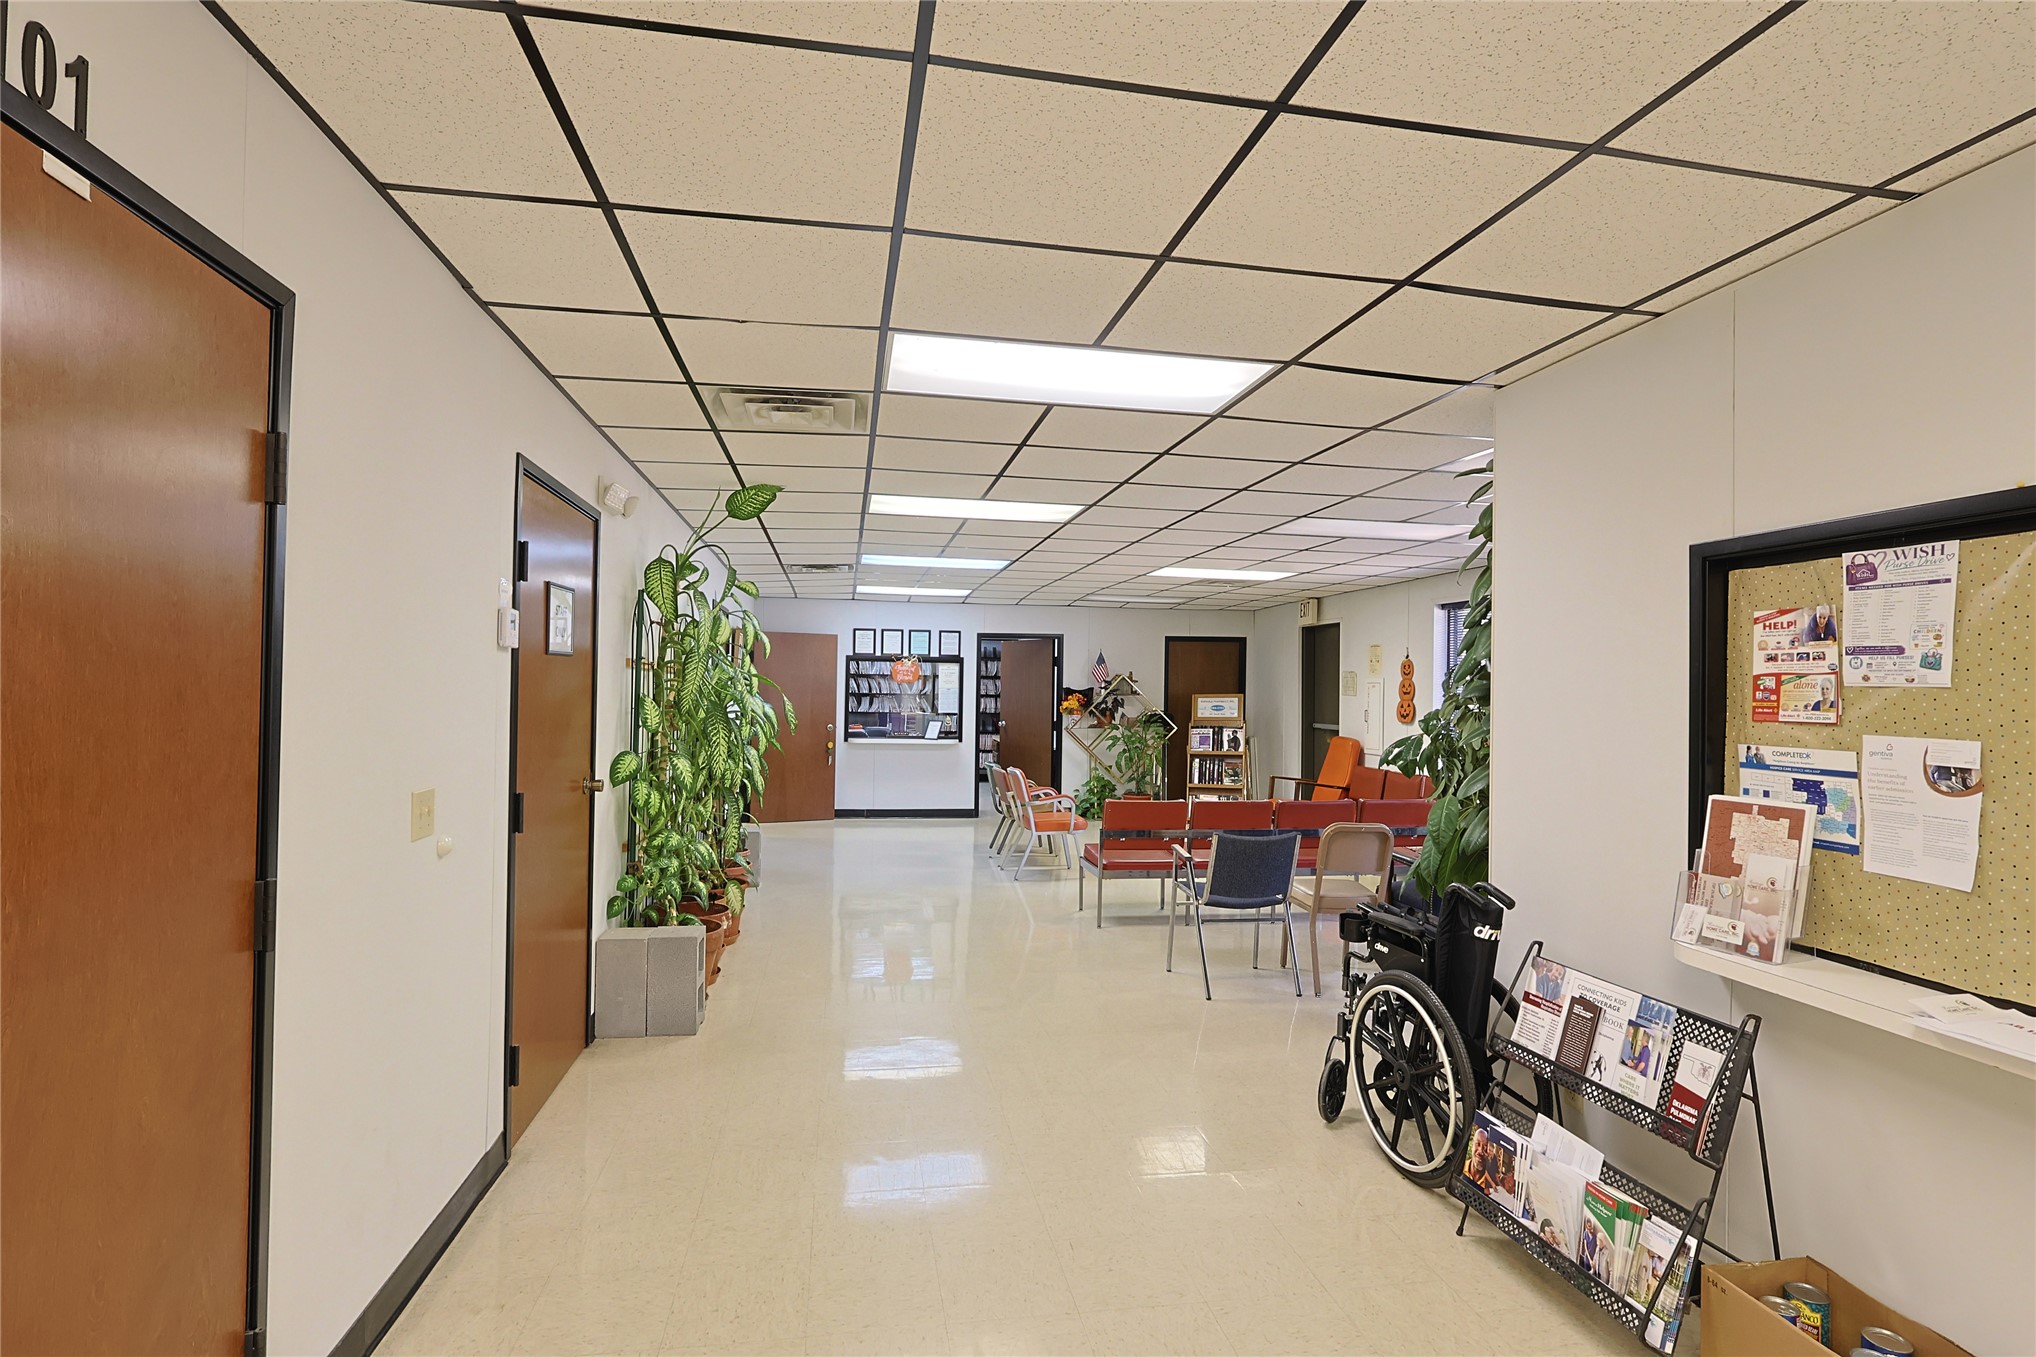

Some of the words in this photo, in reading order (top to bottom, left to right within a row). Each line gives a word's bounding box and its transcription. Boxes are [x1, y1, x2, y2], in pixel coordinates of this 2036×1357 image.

[1893, 544, 1946, 560] WISH
[1884, 559, 1914, 570] Purse
[1918, 556, 1945, 566] Drive
[1763, 620, 1796, 630] HELP!
[1794, 680, 1818, 690] alone
[1868, 771, 1907, 780] Understanding
[1375, 942, 1389, 953] drive
[1578, 984, 1613, 1001] CONNECTING
[1614, 997, 1627, 1006] KIDS
[1589, 996, 1621, 1012] COVERAGE
[1620, 1078, 1635, 1088] WHERE
[1625, 1073, 1636, 1082] CARE
[1619, 1082, 1639, 1096] MATTERS
[1672, 1099, 1698, 1116] OKLAHOMA
